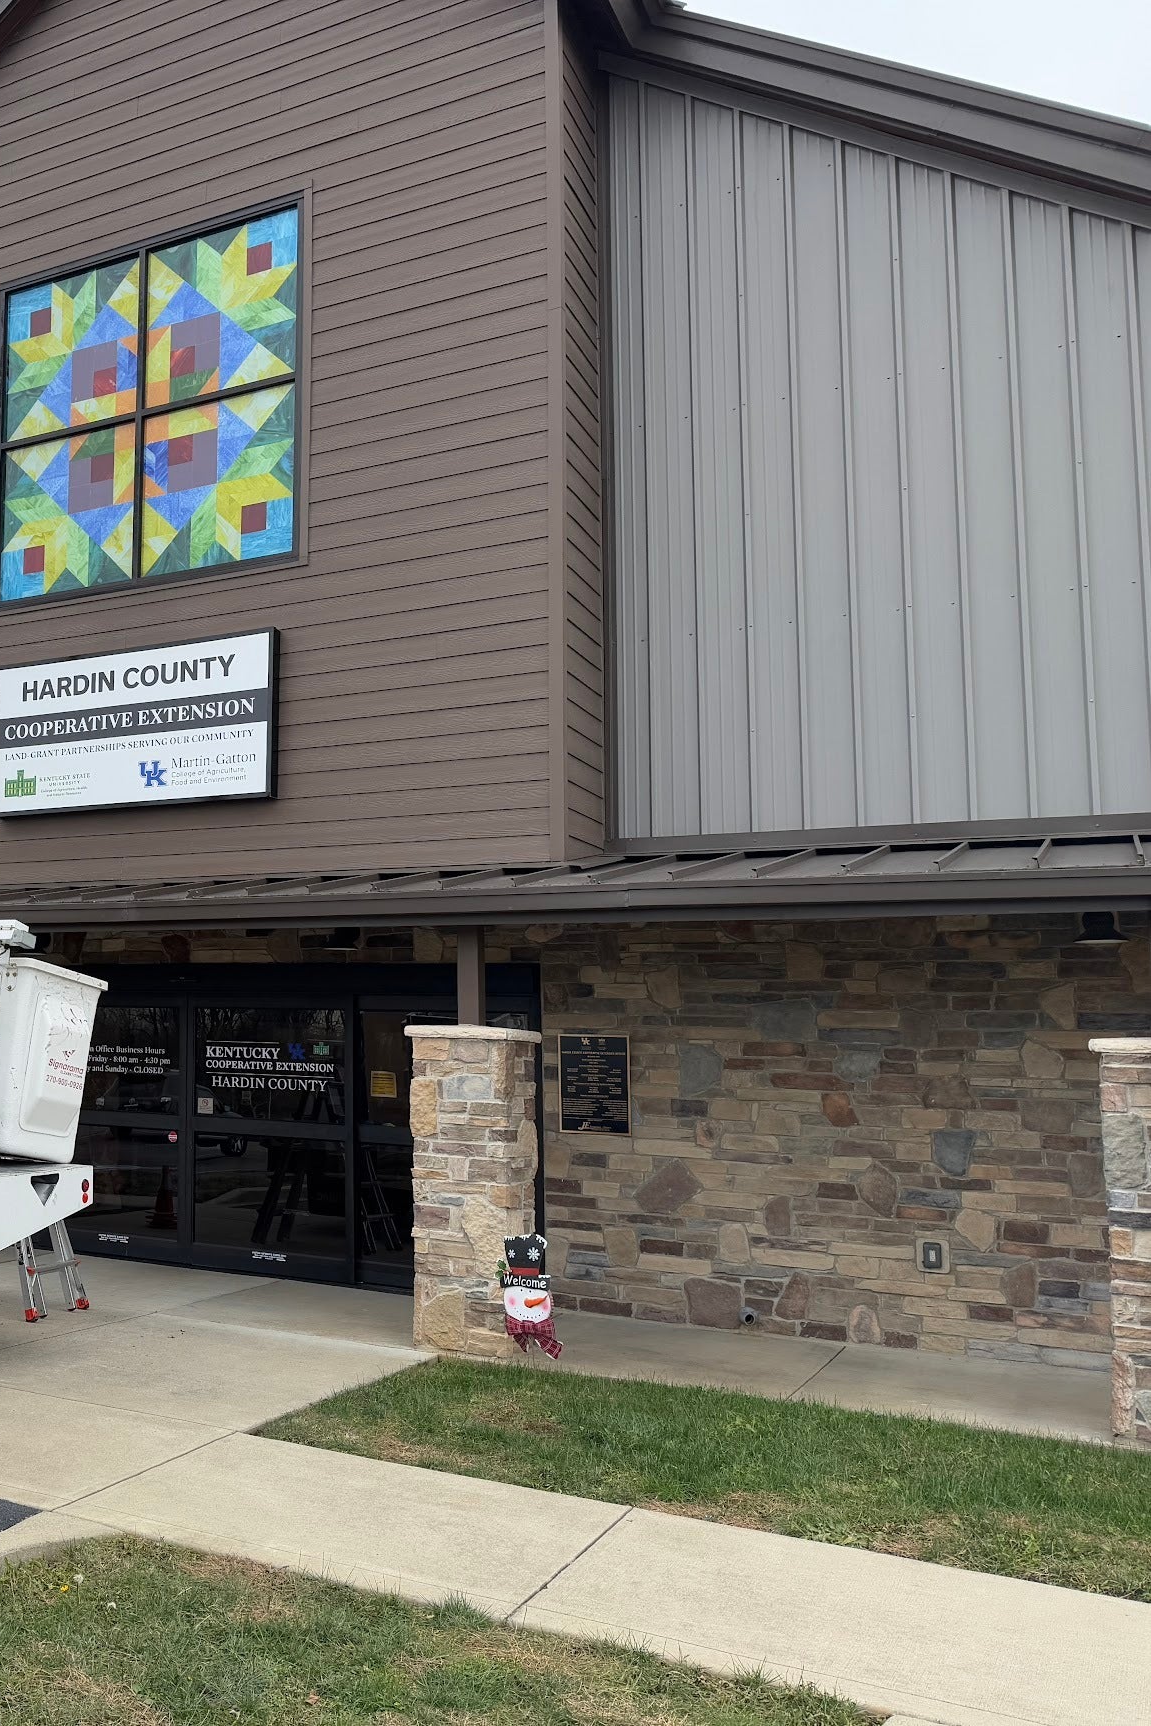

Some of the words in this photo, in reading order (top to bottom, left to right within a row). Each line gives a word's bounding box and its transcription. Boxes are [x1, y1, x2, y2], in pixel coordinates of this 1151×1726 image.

[22, 670, 115, 702] HARDIN
[122, 653, 236, 690] COUNTY
[4, 711, 133, 741] COOPERATIVE
[138, 697, 256, 726] EXTENSION
[5, 748, 59, 761] LAND-GRANT
[61, 742, 126, 756] PARTNERSHIPS
[128, 737, 168, 749] SERVING
[169, 735, 190, 745] OUR
[191, 729, 254, 743] COMMUNITY
[171, 753, 256, 769] Martin-Gatton
[171, 771, 196, 780] College
[171, 779, 188, 787] Food
[189, 777, 202, 785] and
[204, 774, 247, 784] Environment
[95, 1045, 115, 1053] Office
[116, 1045, 143, 1054] Business
[145, 1046, 166, 1055] Hours
[206, 1046, 280, 1059] KENTUCKY
[48, 1058, 84, 1075] Signarama
[88, 1055, 109, 1064] Friday
[206, 1059, 273, 1070] COOPERATIVE
[276, 1062, 334, 1073] EXTENSION
[105, 1065, 129, 1074] Sunday
[133, 1066, 164, 1074] CLOSED
[212, 1075, 265, 1089] HARDIN
[268, 1078, 328, 1092] COUNTY
[504, 1275, 547, 1289] Welcome
